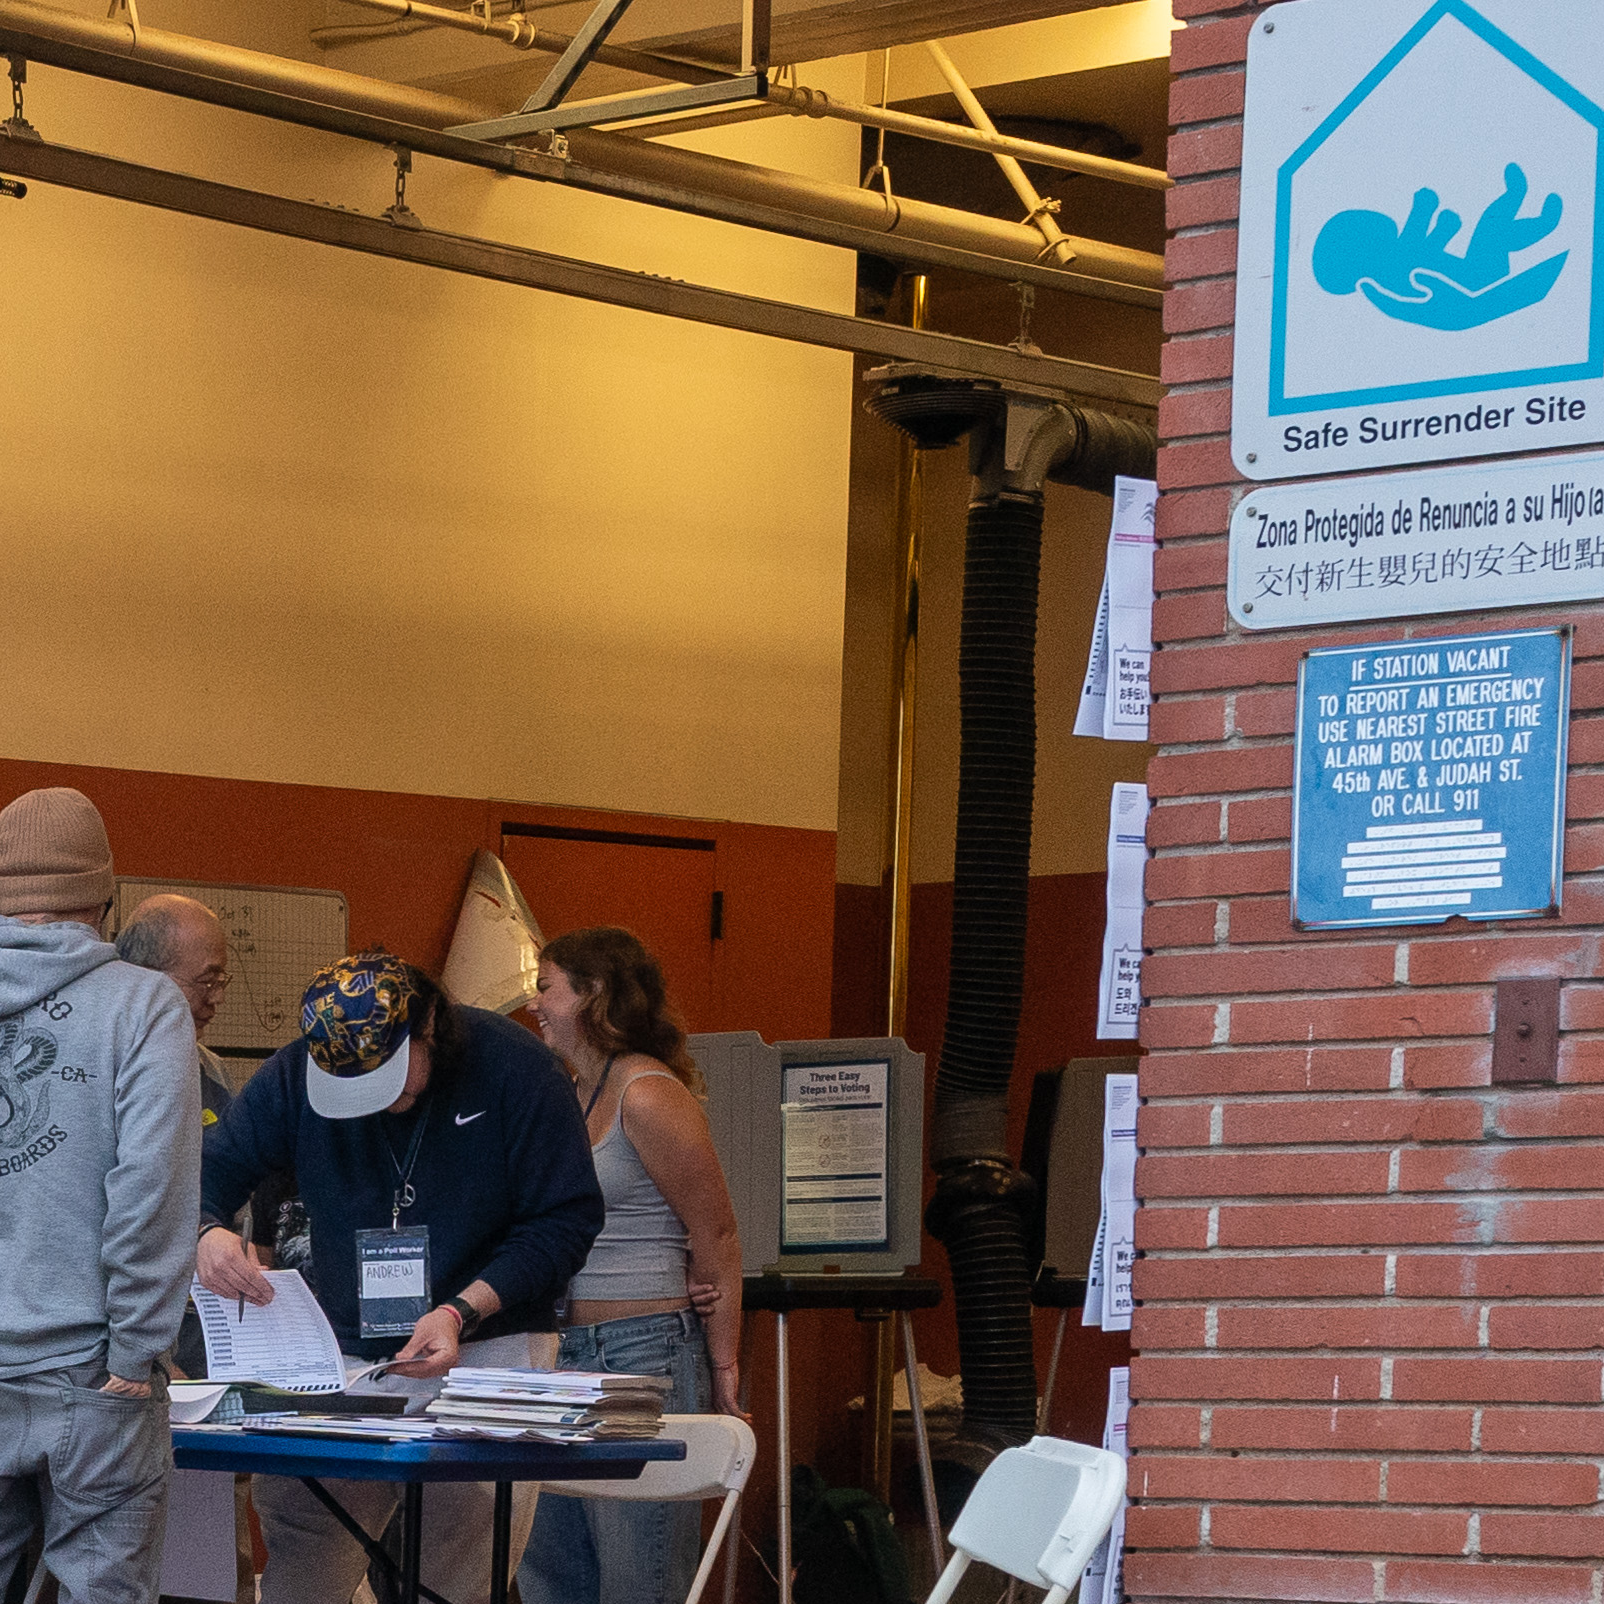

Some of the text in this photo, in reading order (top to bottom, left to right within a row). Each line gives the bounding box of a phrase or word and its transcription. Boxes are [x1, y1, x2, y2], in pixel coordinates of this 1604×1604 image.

[1283, 396, 1586, 453] Safe Surrender Site
[1255, 513, 1297, 549] Zona
[1304, 502, 1384, 543] Protegida
[1391, 499, 1412, 535] de
[1419, 491, 1498, 532] Renuncia
[1505, 497, 1515, 524] a
[1523, 495, 1544, 523] su
[1550, 483, 1585, 520] Hijo
[1255, 536, 1604, 599] 交付新生嬰兒的安全地點
[1351, 645, 1512, 681] IF STATION VACANT
[1317, 676, 1545, 717] TO REPORT AN EMERGENCY
[1317, 704, 1542, 743] USE NEAREST STREET FIRE
[1323, 730, 1533, 769] ALARM BOX LOCATED AT
[1332, 758, 1522, 794] 45th AVE. & JUDAH ST.
[1371, 788, 1479, 817] OR CALL 911
[799, 1083, 870, 1096] Steps to Voting
[809, 1071, 861, 1083] Three Easy
[366, 1262, 413, 1279] ANDREW
